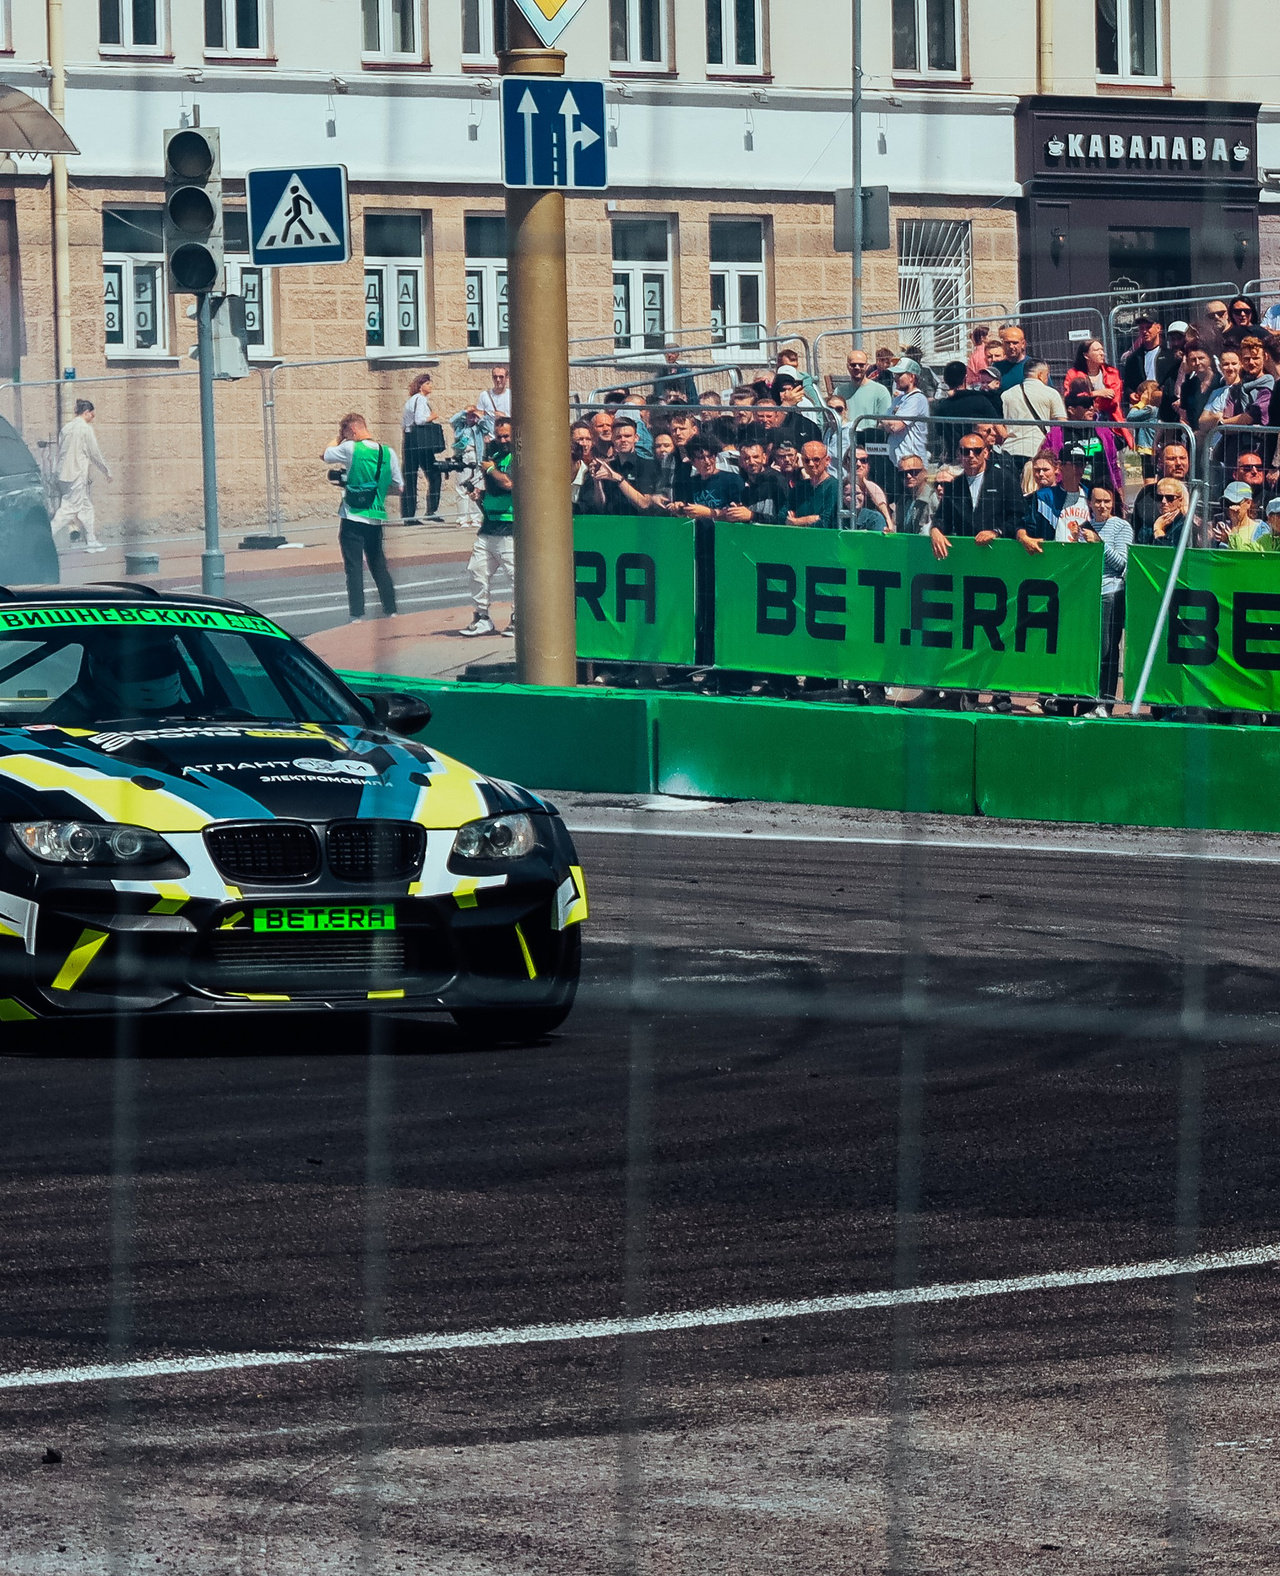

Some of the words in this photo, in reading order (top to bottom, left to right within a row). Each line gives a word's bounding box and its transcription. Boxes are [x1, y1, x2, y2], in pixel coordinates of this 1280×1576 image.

[1068, 133, 1229, 161] КАВАЛАВА
[574, 550, 656, 625] RA
[182, 761, 291, 776] АТЛАНТ
